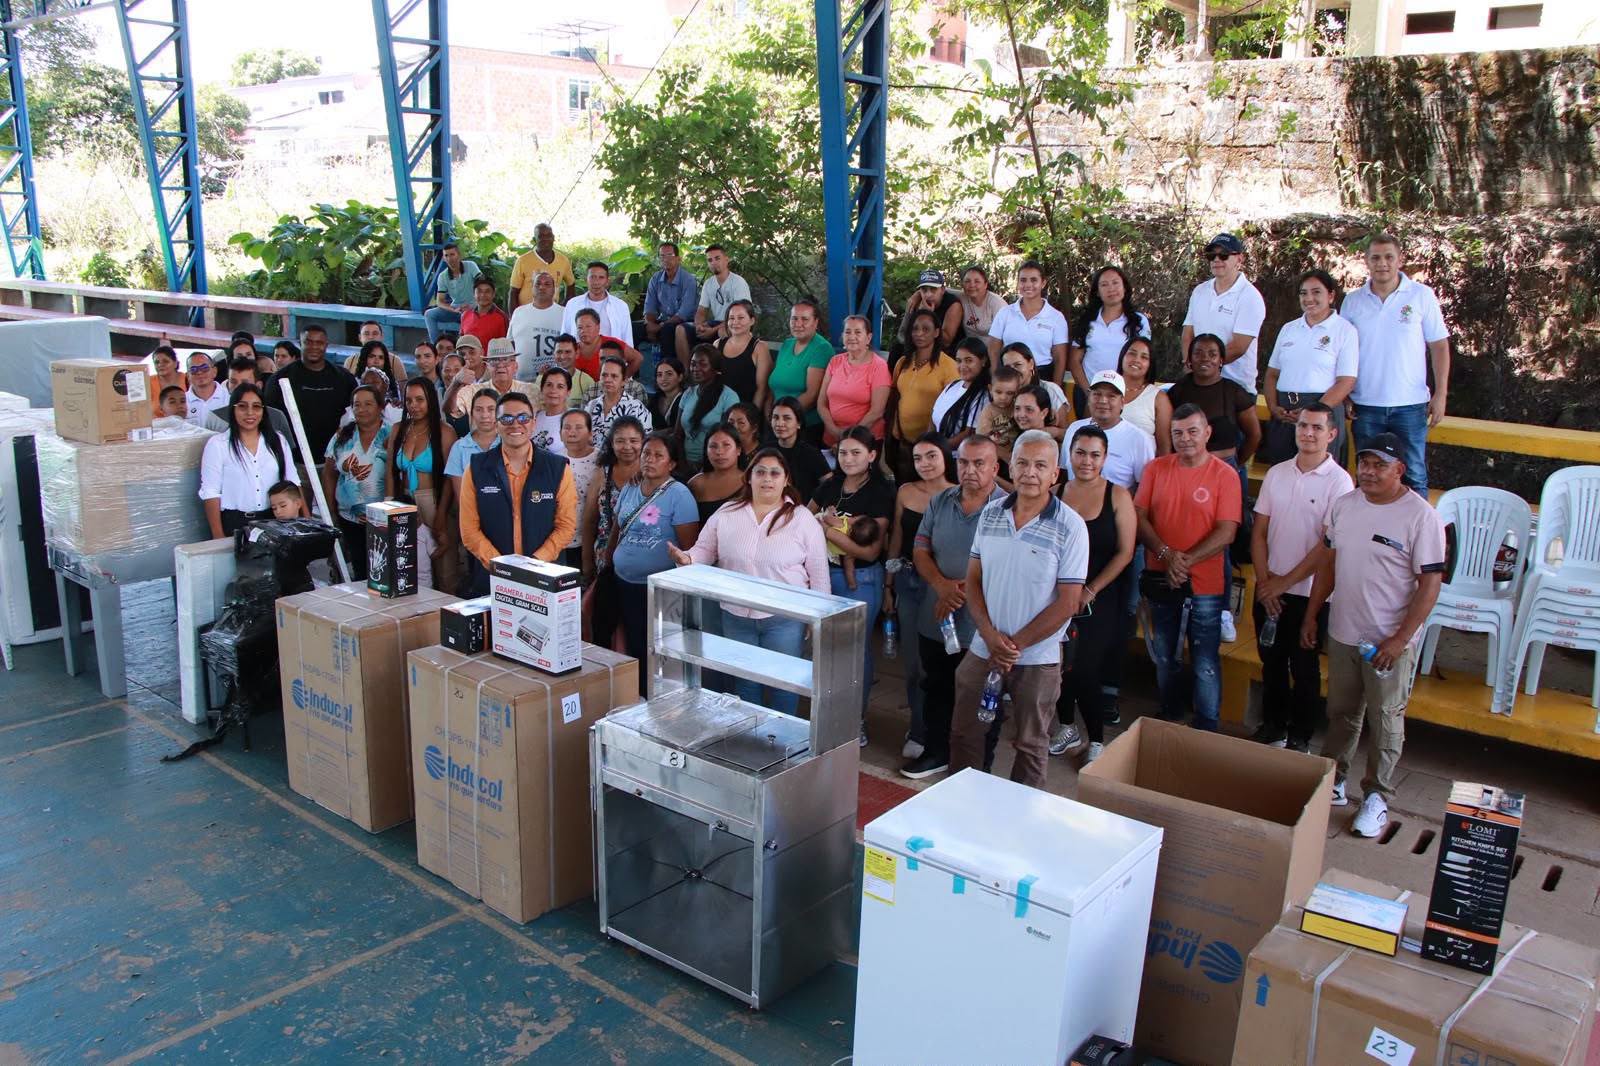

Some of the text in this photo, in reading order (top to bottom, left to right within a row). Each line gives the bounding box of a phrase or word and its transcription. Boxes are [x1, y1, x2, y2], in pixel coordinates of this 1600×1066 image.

[495, 585, 524, 598] GRAMERA
[525, 593, 547, 605] DIGITAL
[495, 594, 548, 614] DIGITAL GRAM SCALE
[564, 700, 577, 717] 20
[669, 751, 678, 766] 8
[1451, 836, 1477, 846] KITCHEN
[1477, 842, 1495, 851] KNIFE
[1372, 1035, 1398, 1057] 23
